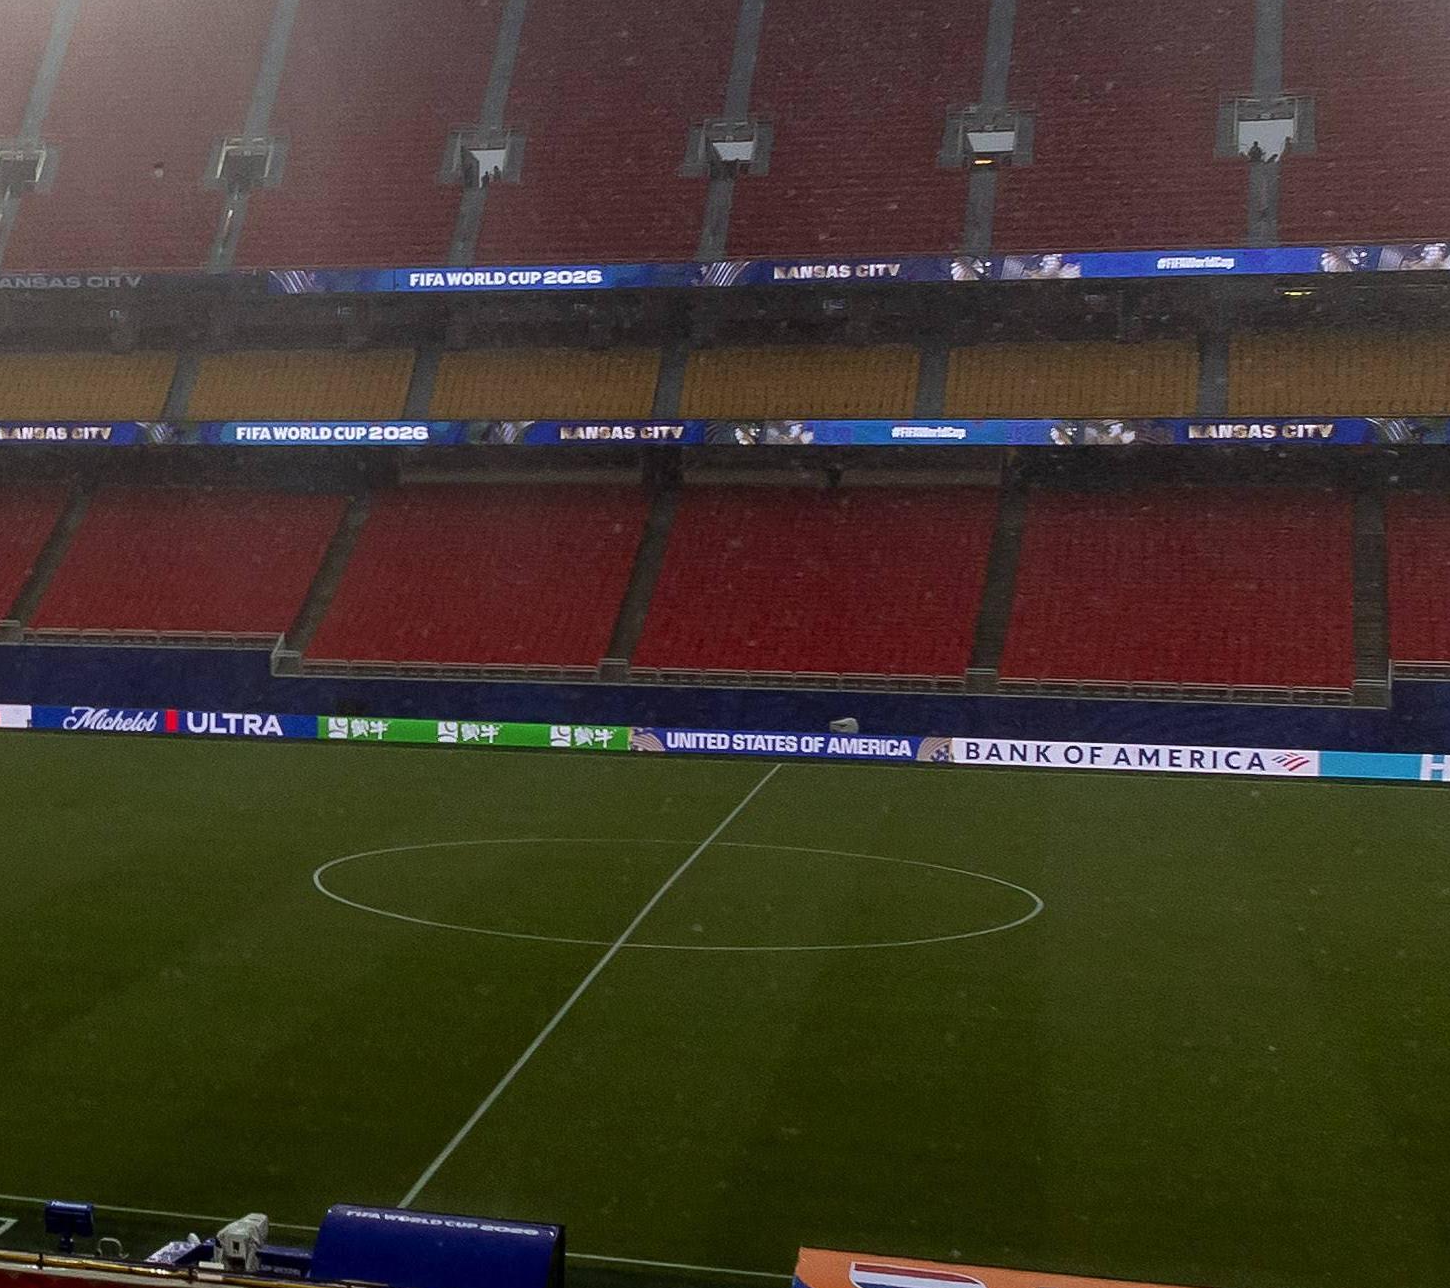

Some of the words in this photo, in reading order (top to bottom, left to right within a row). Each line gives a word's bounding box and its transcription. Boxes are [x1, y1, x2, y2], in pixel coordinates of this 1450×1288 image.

[409, 273, 445, 287] FIFA
[446, 272, 506, 286] WORLD
[508, 271, 542, 285] CUP
[543, 270, 602, 285] 2026
[773, 265, 851, 279] KANSAS
[855, 263, 900, 278] CITY
[71, 426, 112, 440] CITY
[236, 426, 272, 440] FIFA
[273, 426, 331, 440] WORLD
[333, 426, 367, 440] CUP
[368, 426, 428, 440] 2026
[560, 426, 636, 440] KANSAS
[640, 426, 684, 439] CITY
[1188, 424, 1277, 438] KANSAS
[1282, 424, 1333, 438] CITY
[62, 706, 159, 732] Michelob
[186, 711, 284, 736] ULTRA
[666, 732, 730, 750] UNITED
[732, 734, 798, 752] STATES
[800, 736, 825, 752] OF
[826, 737, 912, 756] AMERICA
[965, 742, 1051, 763] BANK
[1064, 745, 1103, 765] OF
[1114, 748, 1266, 771] AMERICA
